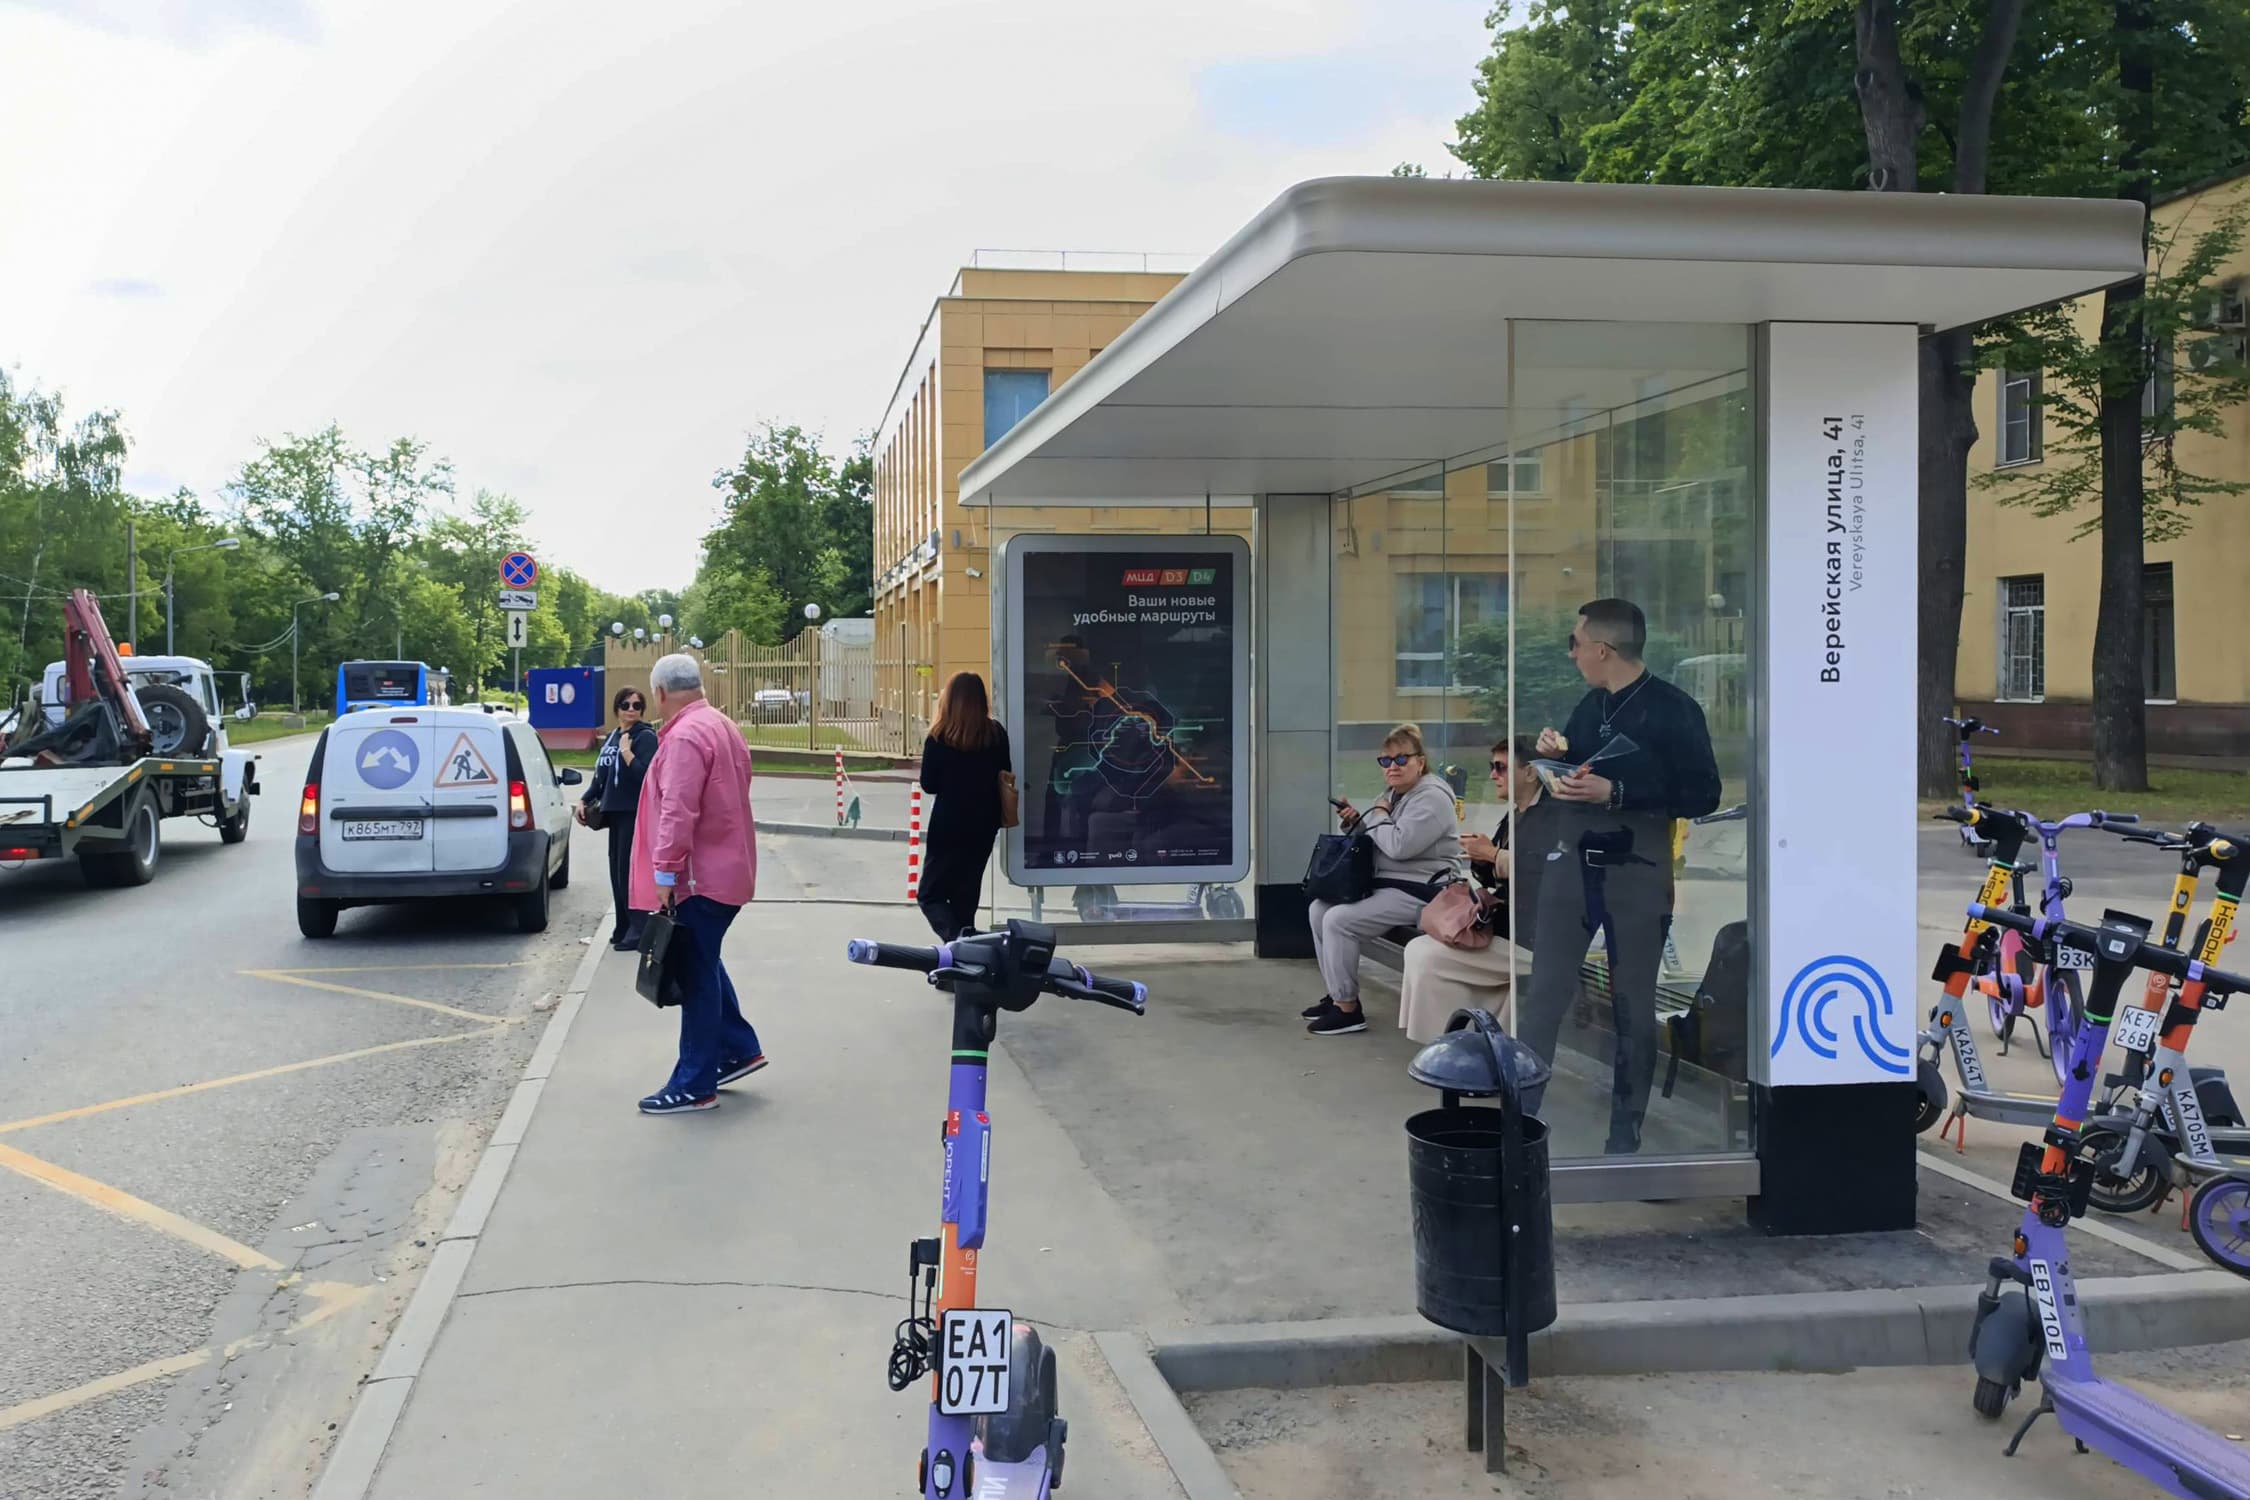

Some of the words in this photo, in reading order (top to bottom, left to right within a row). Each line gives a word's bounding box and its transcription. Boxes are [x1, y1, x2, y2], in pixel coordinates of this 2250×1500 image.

[1823, 417, 1843, 441] 41
[1851, 414, 1864, 430] 41
[1849, 435, 1866, 489] Ulitsa,
[1827, 449, 1846, 534] улица,
[1849, 495, 1866, 591] Vereyskaya
[1073, 610, 1137, 626] удобные
[1140, 611, 1216, 625] маршруты
[1128, 594, 1167, 607] Ваши
[1170, 596, 1216, 607] новые
[1820, 542, 1845, 682] Верейская
[400, 820, 420, 832] 797
[2200, 904, 2232, 967] HOOSH
[943, 1141, 953, 1202] ЮРЕНТ
